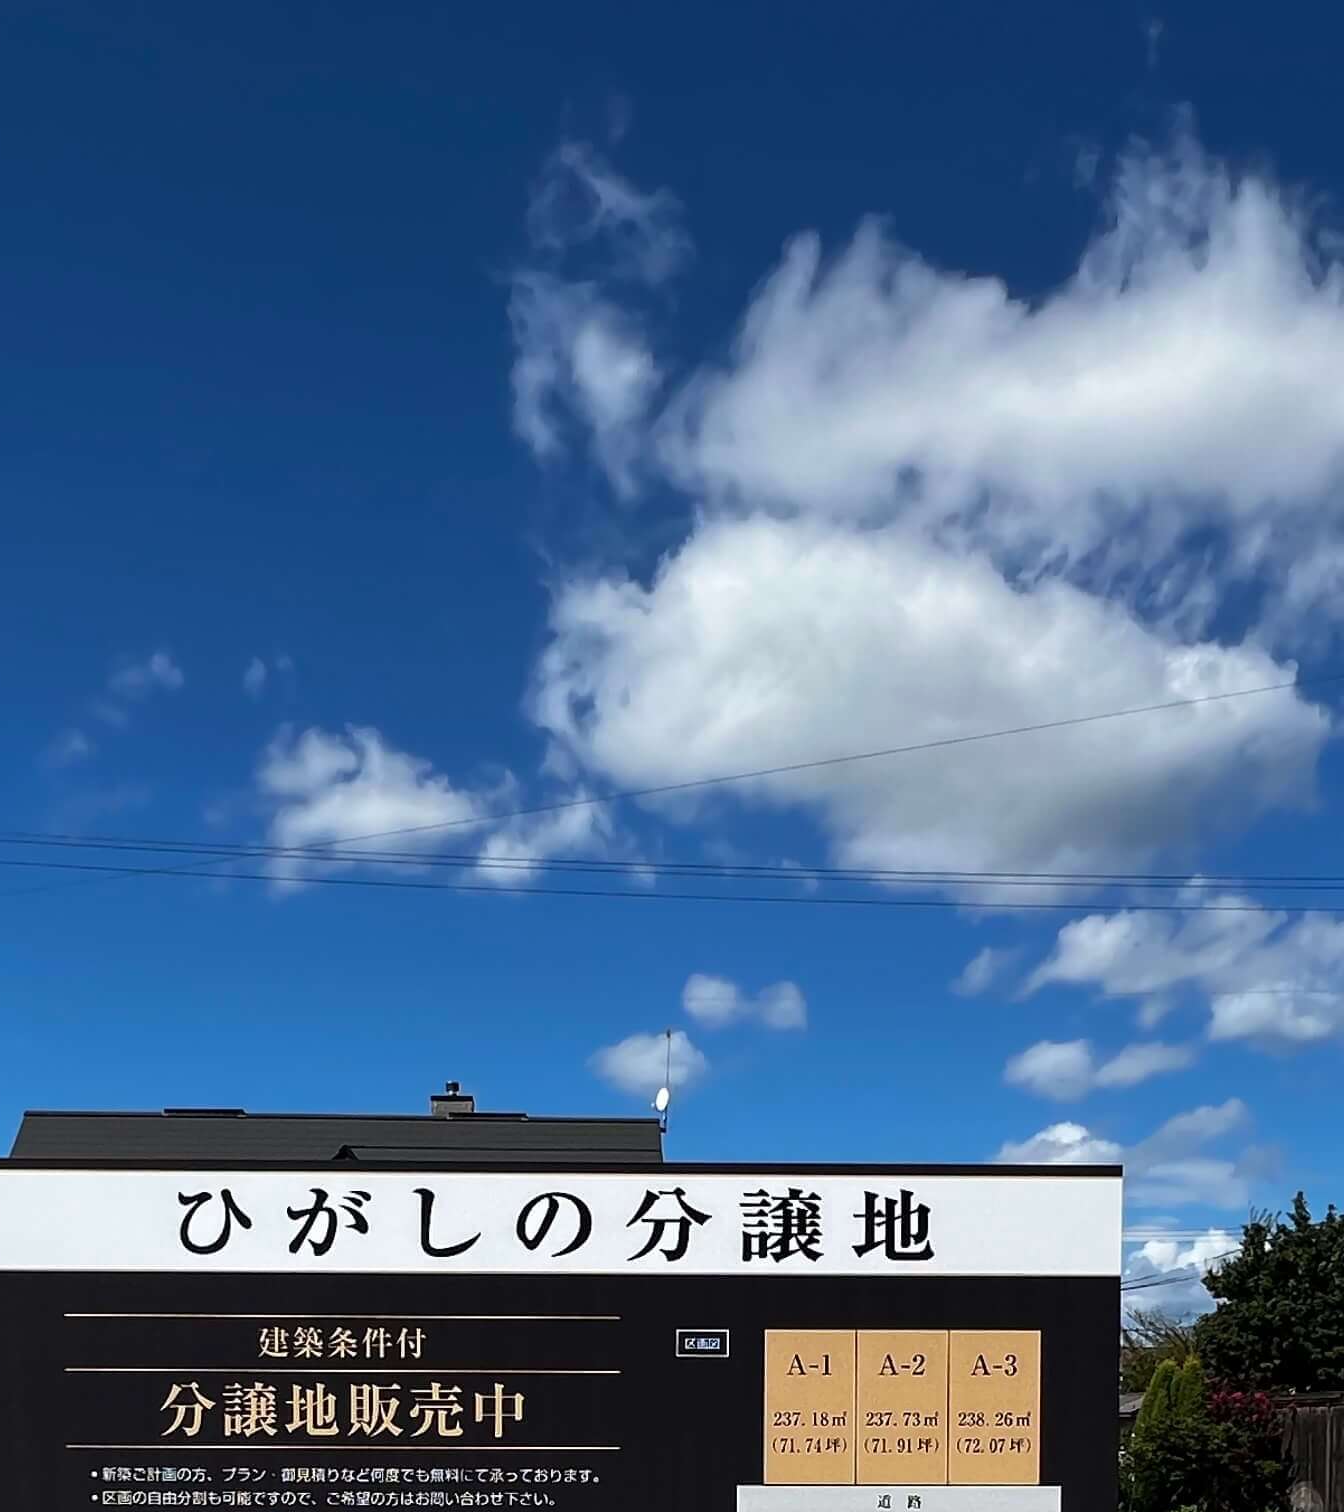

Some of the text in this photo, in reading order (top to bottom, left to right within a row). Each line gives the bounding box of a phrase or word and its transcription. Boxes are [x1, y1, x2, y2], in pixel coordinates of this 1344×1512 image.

[179, 1188, 934, 1262] ひがしの分譲地
[259, 1327, 426, 1358] 建築条件付
[787, 1354, 831, 1375] A-1
[879, 1354, 925, 1375] A-2
[971, 1355, 1017, 1376] A-3
[160, 1382, 524, 1437] 分譲地販売中
[877, 1494, 921, 1509] 道路
